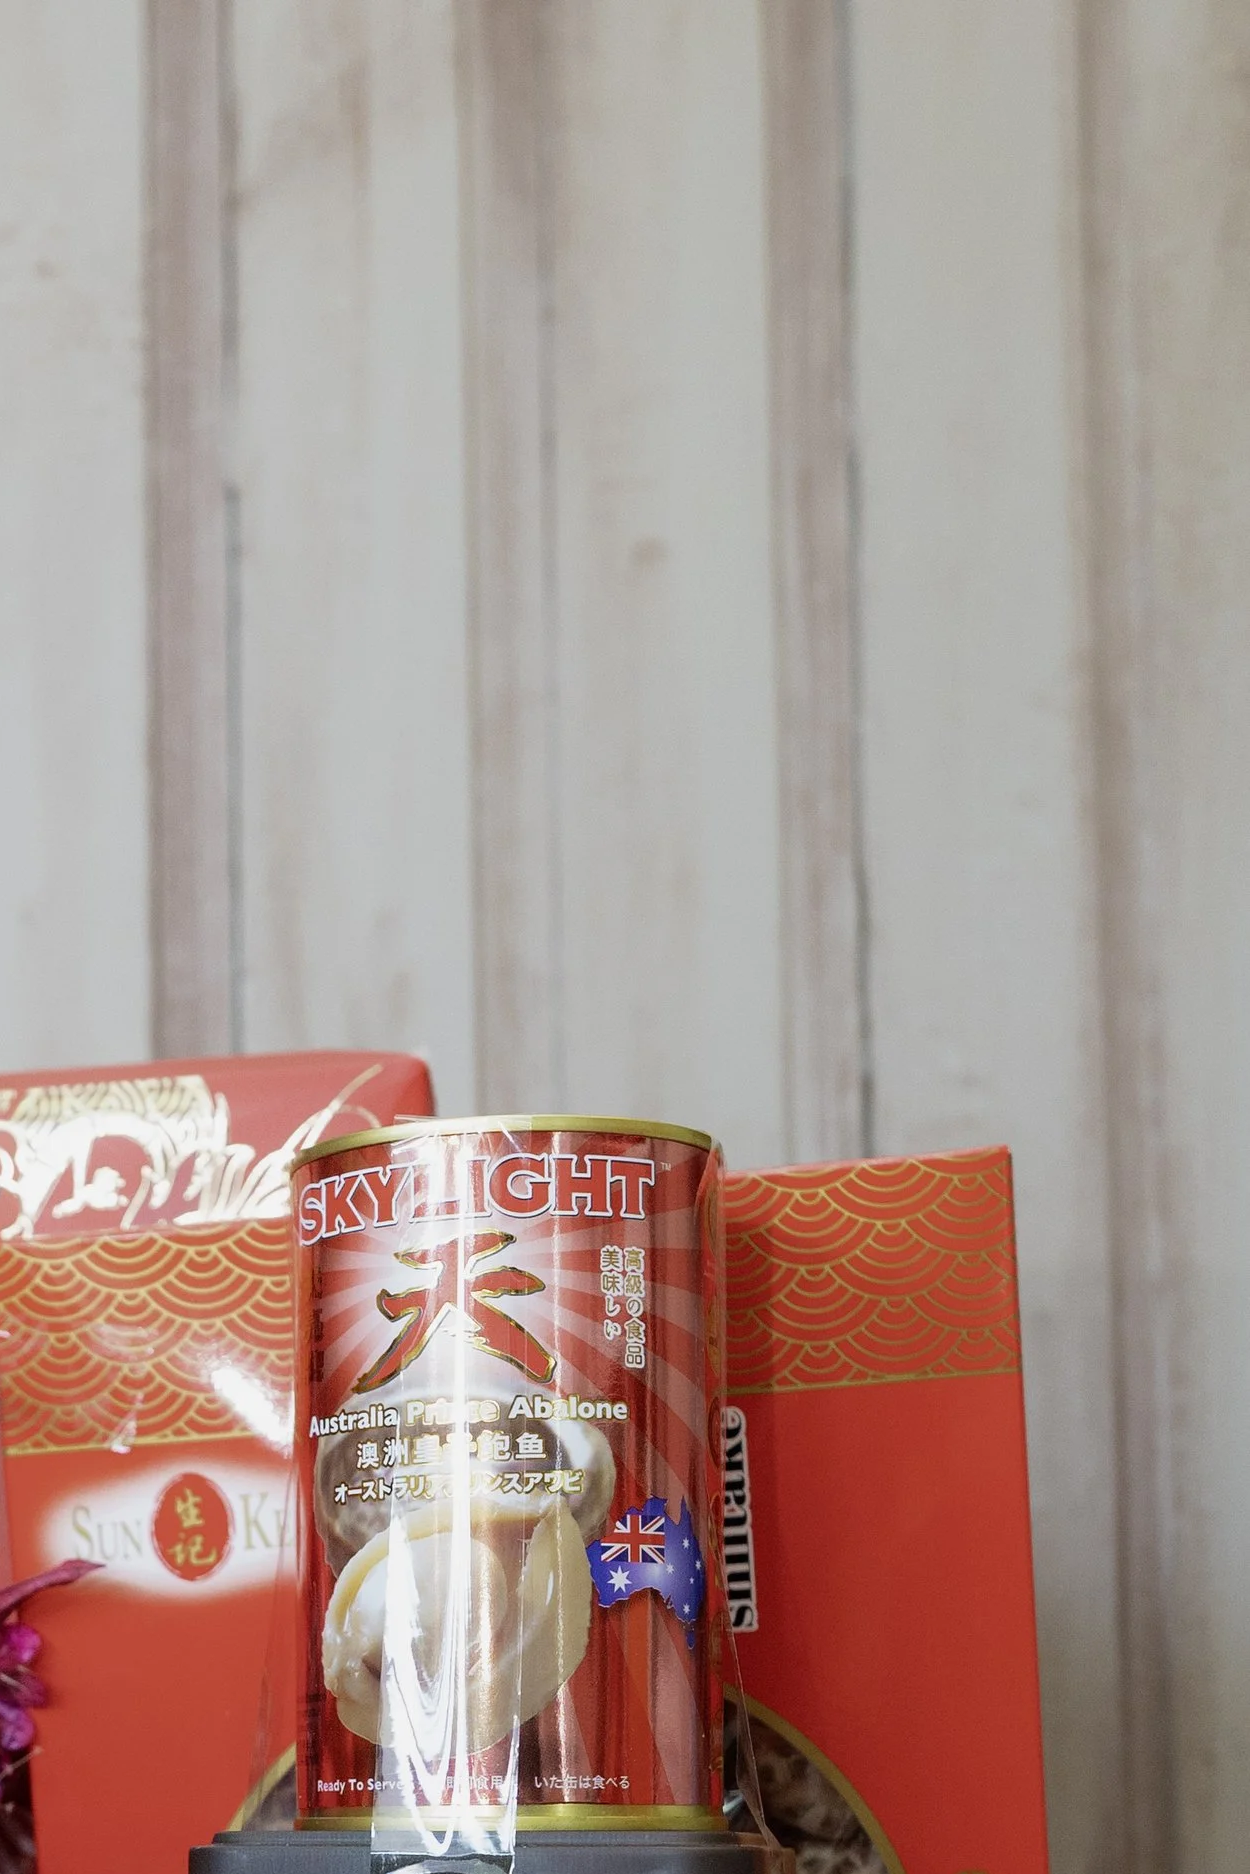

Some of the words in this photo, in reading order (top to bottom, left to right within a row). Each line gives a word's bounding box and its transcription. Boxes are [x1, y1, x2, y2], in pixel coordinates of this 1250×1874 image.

[300, 1152, 656, 1247] SKYLIGHT
[600, 1245, 623, 1341] 美味しい
[309, 1406, 399, 1438] Australia
[406, 1399, 500, 1426] Price
[509, 1396, 629, 1421] Abalone
[317, 1779, 345, 1795] Ready
[348, 1778, 364, 1792] To
[366, 1777, 404, 1792] Serve
